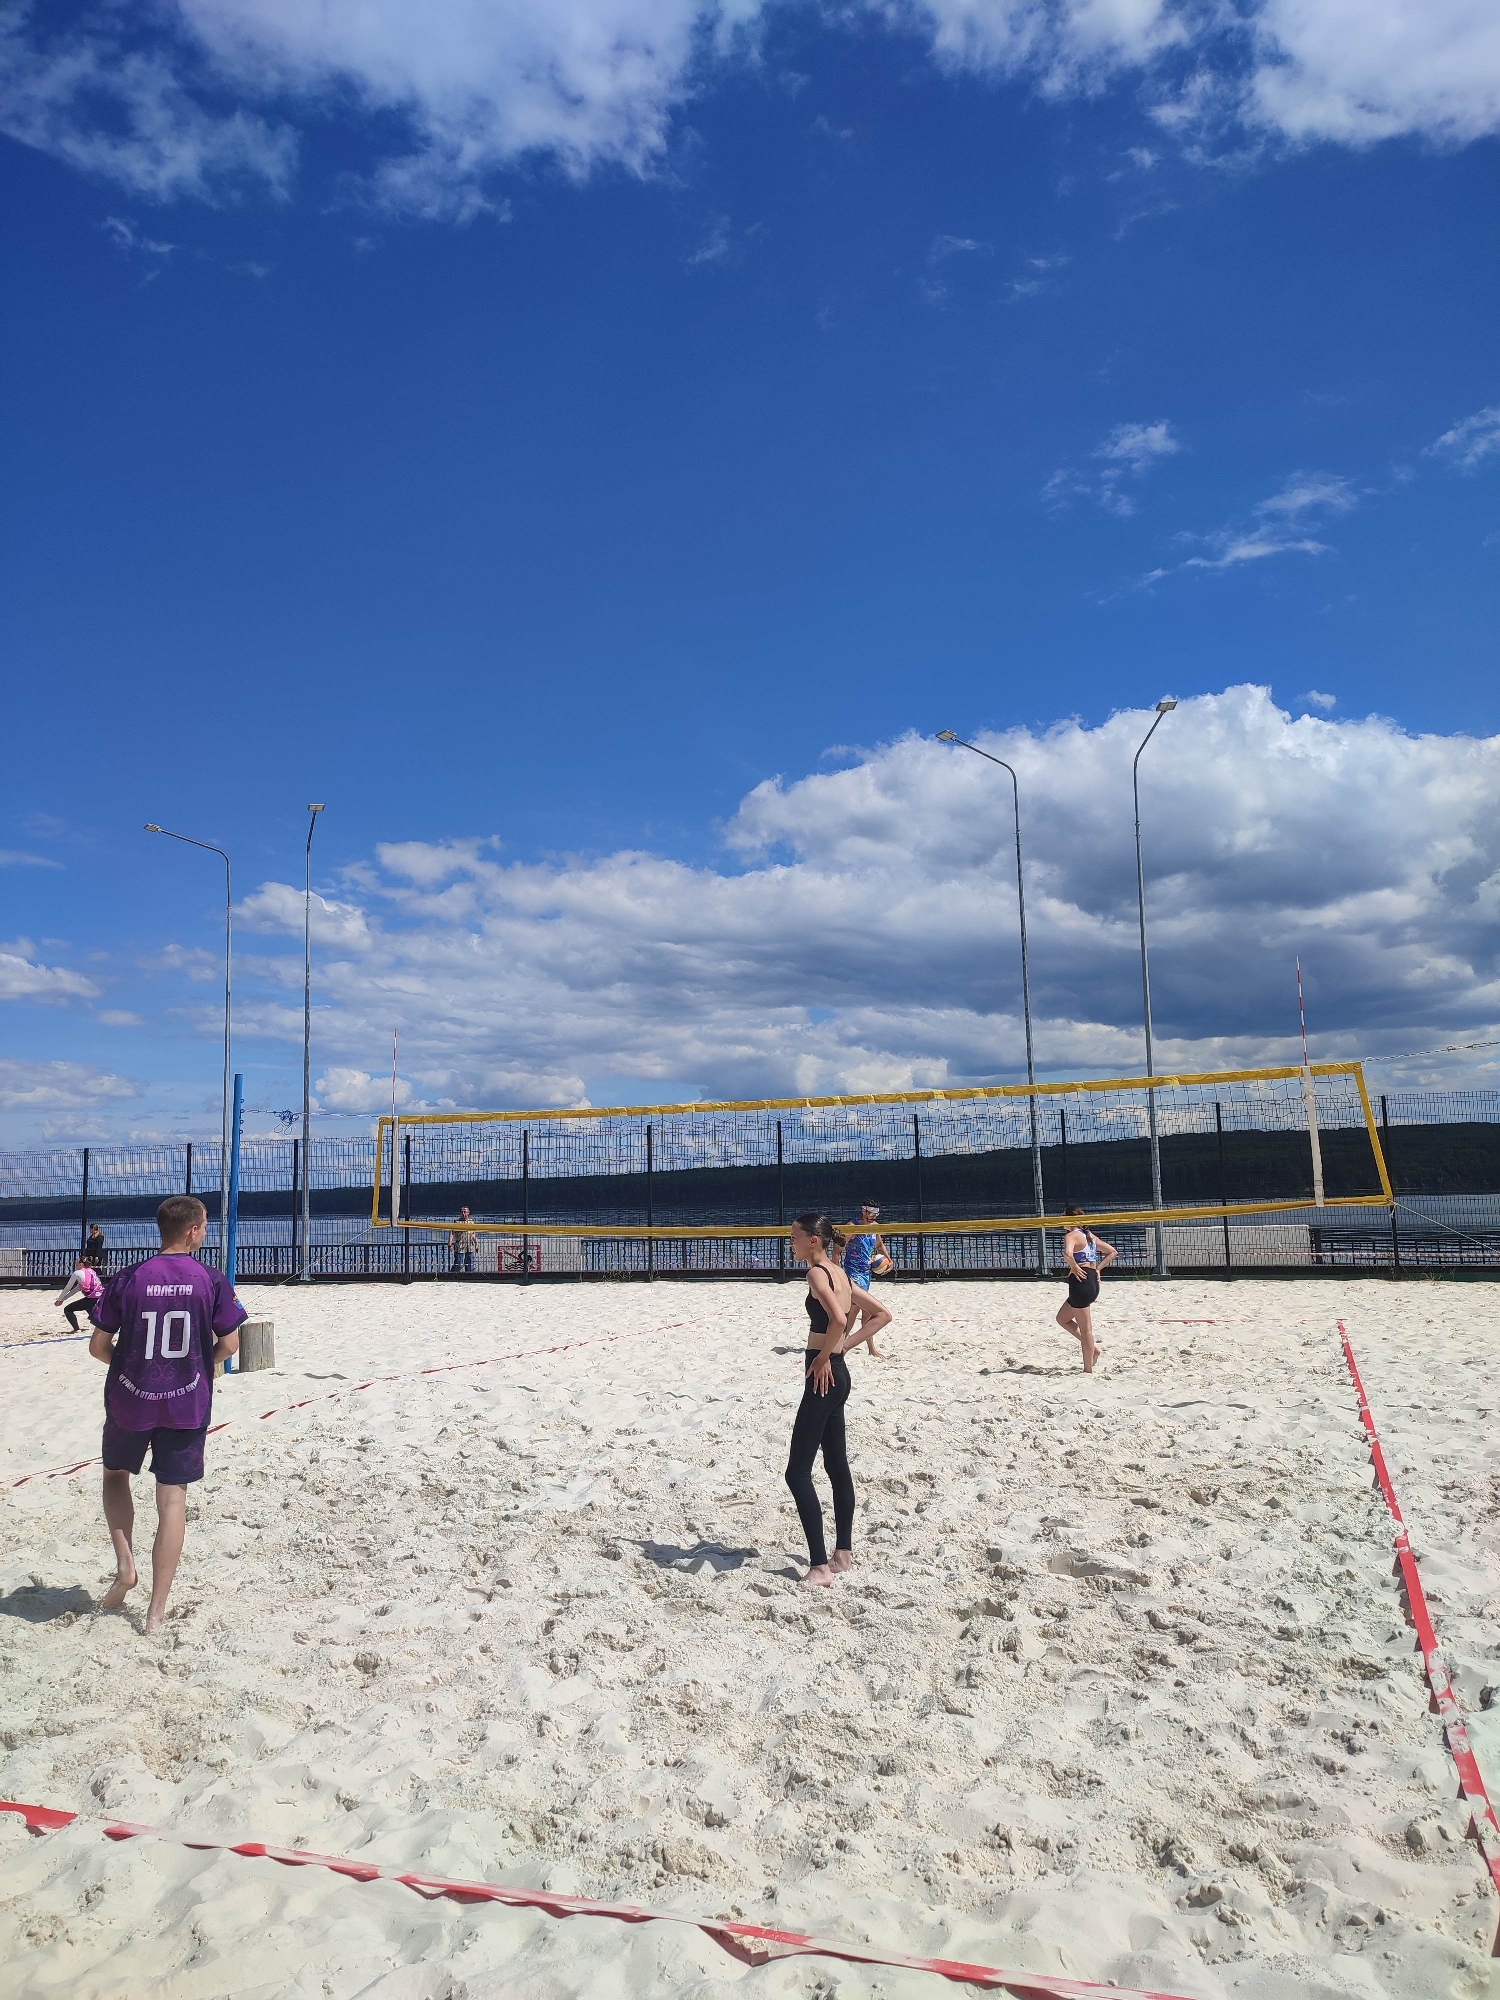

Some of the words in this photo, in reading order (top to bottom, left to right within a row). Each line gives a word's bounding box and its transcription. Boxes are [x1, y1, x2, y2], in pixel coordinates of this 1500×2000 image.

[146, 1285, 193, 1296] КОЛЕГОВ
[141, 1310, 191, 1359] 10
[176, 1387, 186, 1397] СО
